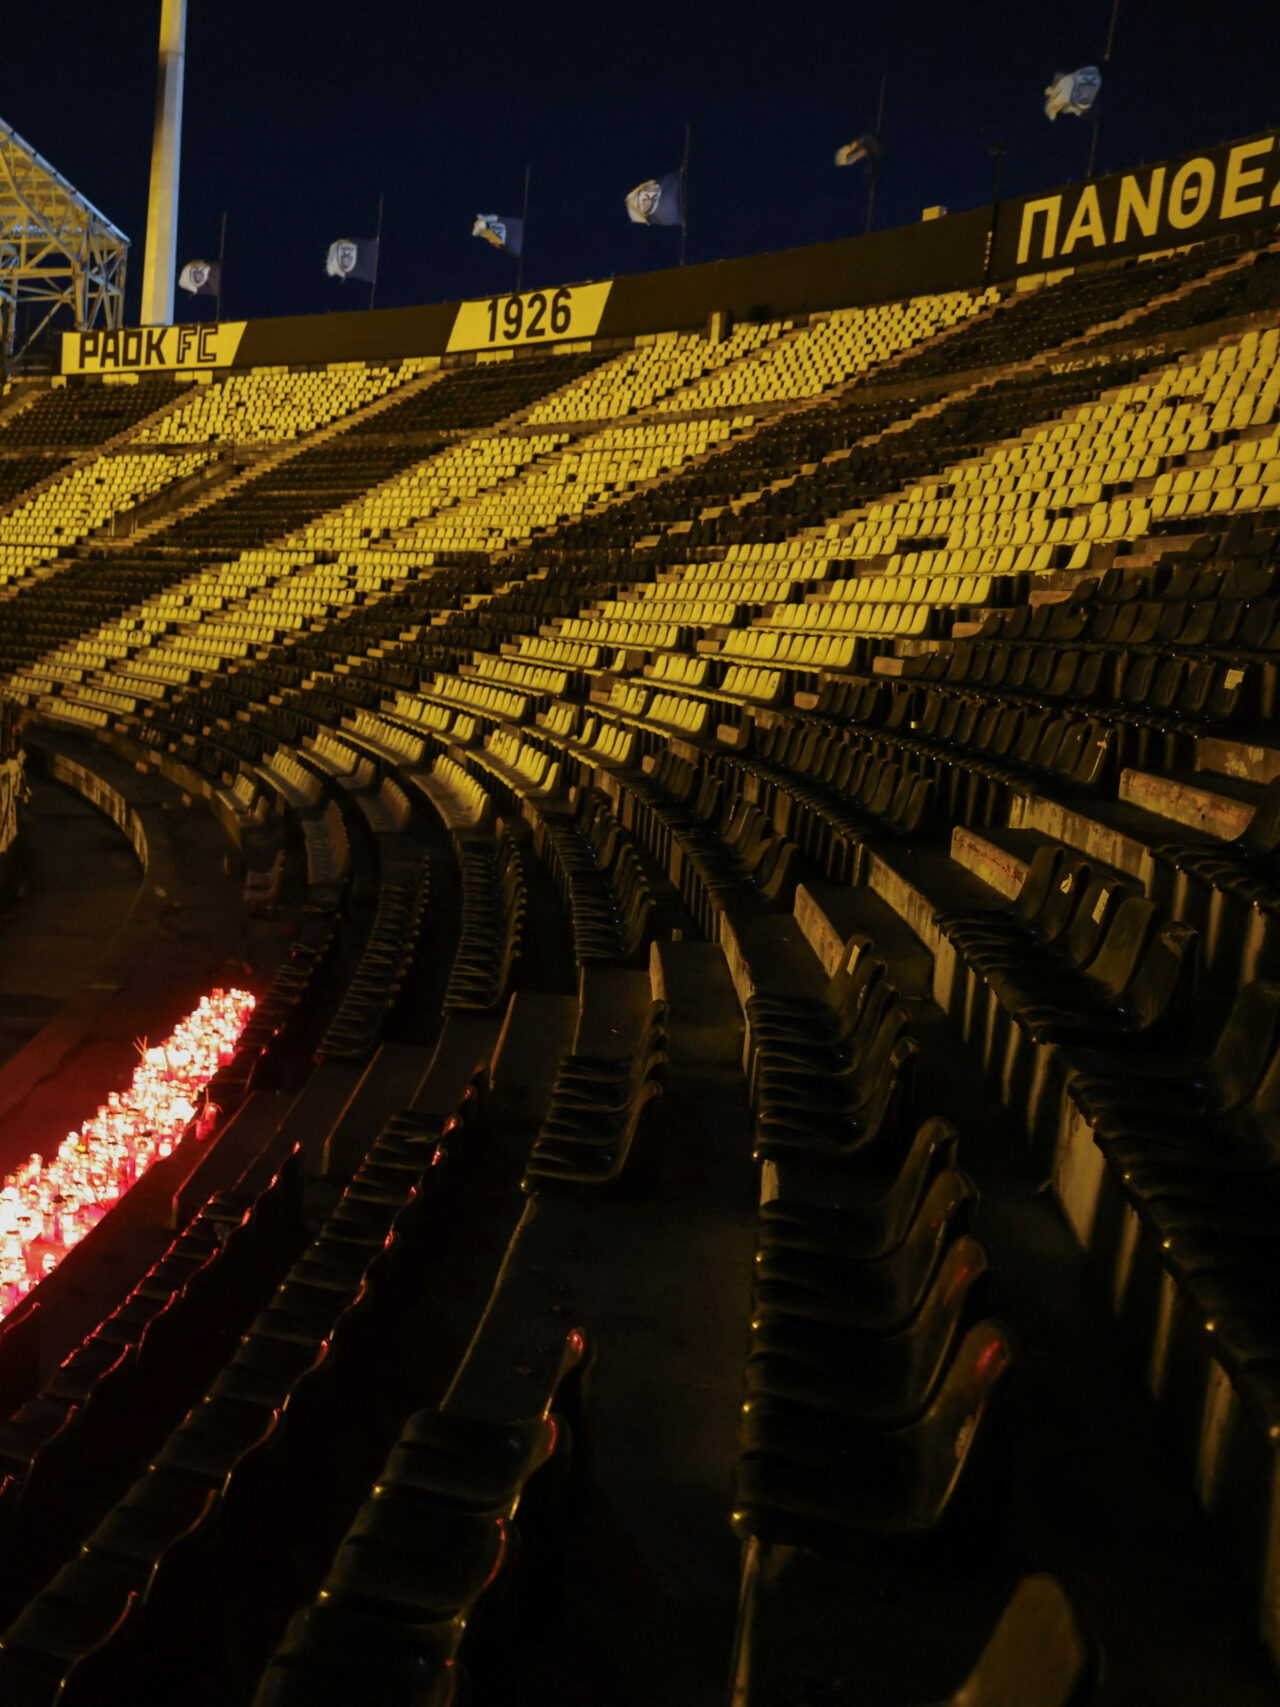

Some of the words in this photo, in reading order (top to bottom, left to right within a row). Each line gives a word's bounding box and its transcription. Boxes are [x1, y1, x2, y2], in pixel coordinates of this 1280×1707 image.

[1017, 132, 1280, 265] ΠΑΝΘΕ
[488, 287, 572, 342] 1926
[79, 329, 168, 369] PAOK
[176, 324, 219, 364] FC
